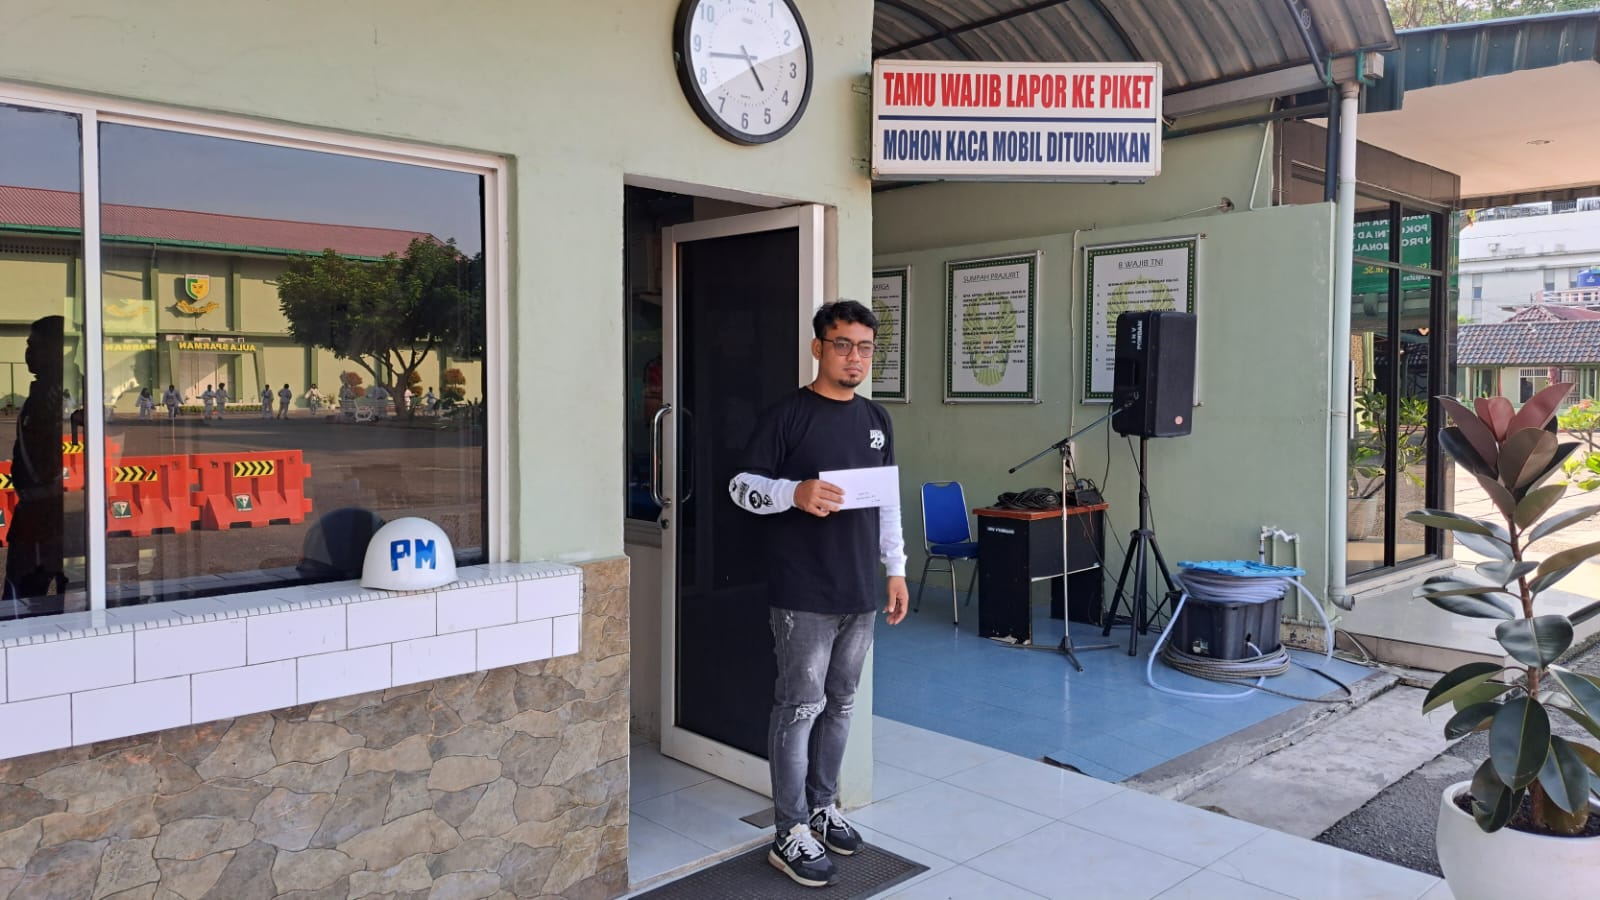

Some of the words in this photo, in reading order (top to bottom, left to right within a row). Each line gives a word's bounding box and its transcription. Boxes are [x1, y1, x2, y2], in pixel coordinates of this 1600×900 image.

[699, 2, 714, 22] 10
[768, 2, 774, 18] 1
[694, 34, 702, 52] 9
[784, 30, 791, 46] 2
[700, 67, 708, 85] 8
[789, 62, 797, 79] 3
[781, 90, 789, 106] 4
[883, 72, 936, 106] TAMU
[941, 73, 1002, 108] WAJIB
[1006, 74, 1067, 108] LAPOR
[1072, 75, 1095, 108] KE
[1100, 75, 1153, 109] PIKET
[718, 96, 726, 113] 7
[741, 112, 748, 129] 6
[764, 108, 771, 124] 5
[883, 129, 941, 160] MOHON
[946, 130, 988, 162] KACA
[992, 130, 1042, 162] MOBIL
[1046, 132, 1150, 163] DITURUNKAN
[1126, 260, 1148, 268] WAJIB
[390, 539, 436, 571] PM
